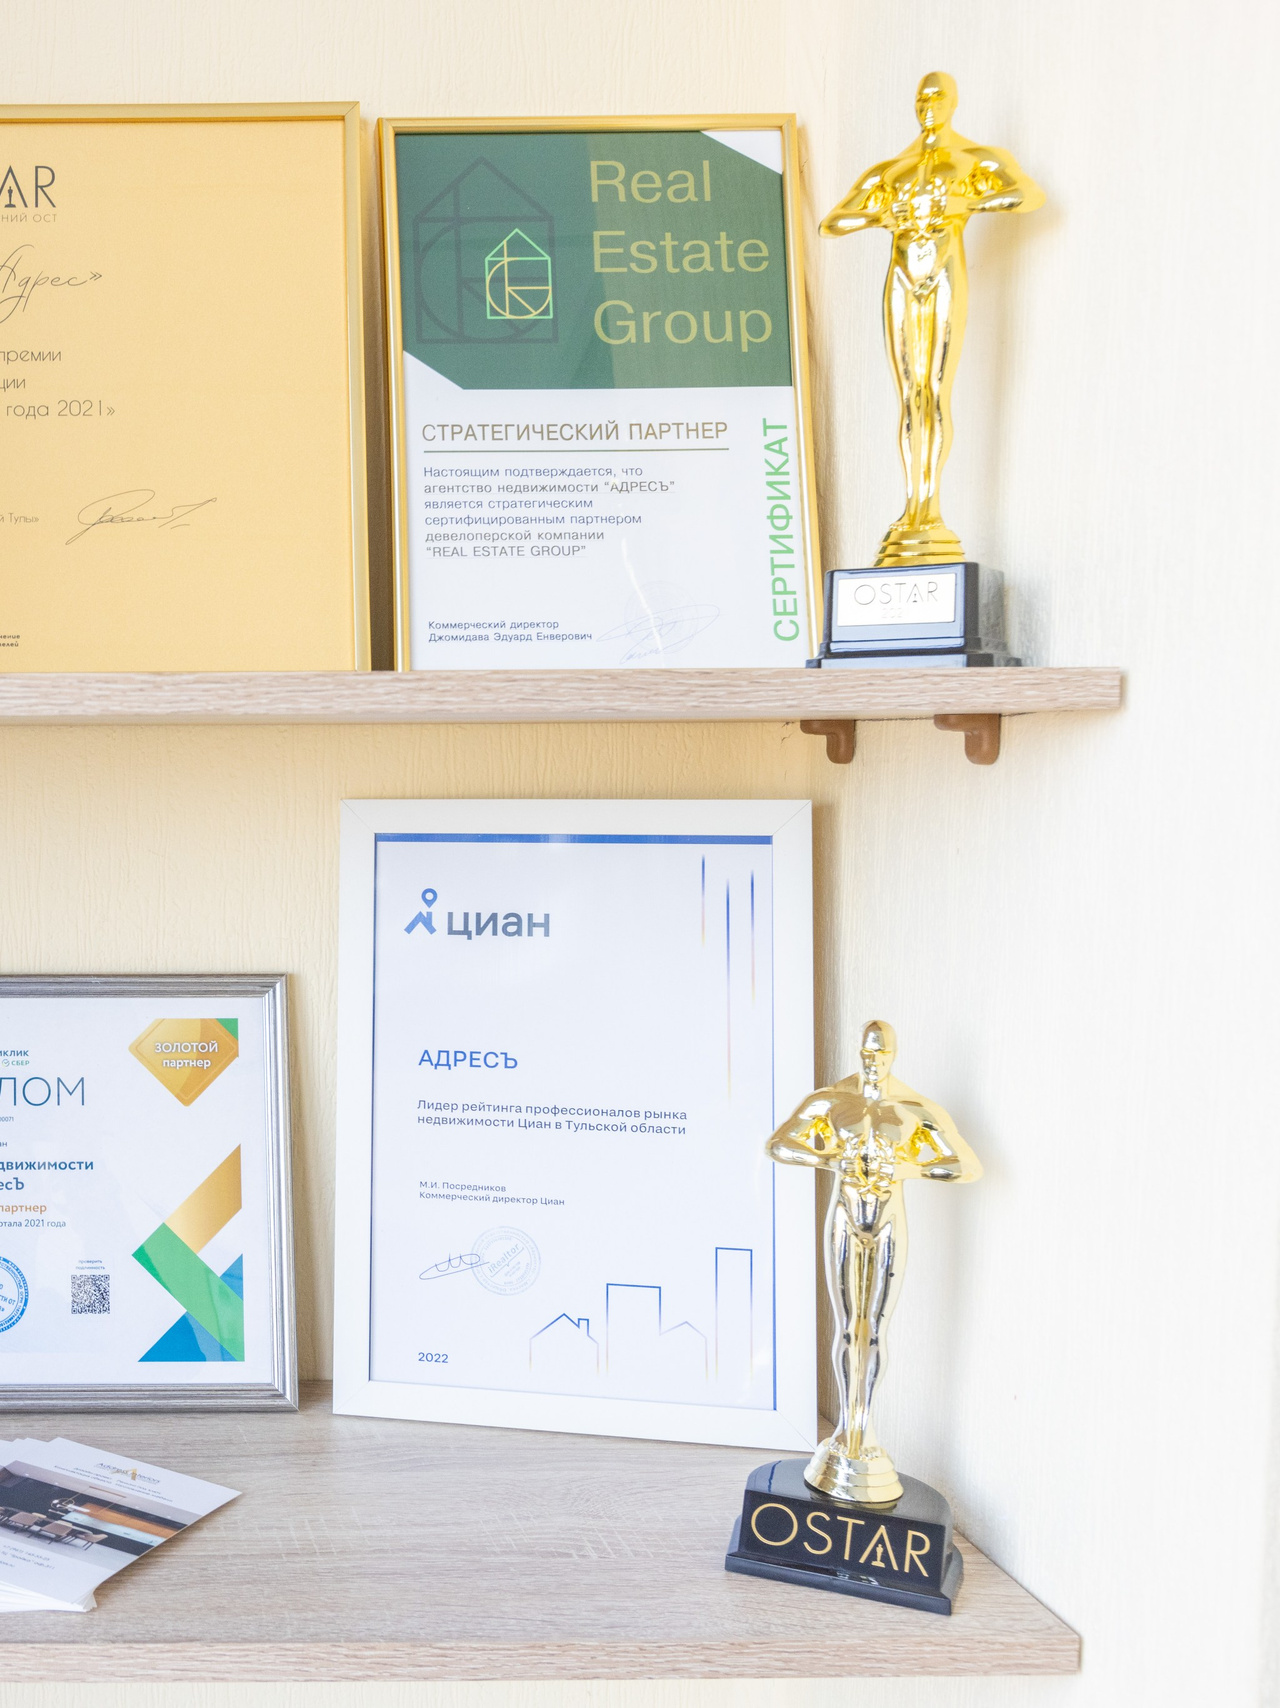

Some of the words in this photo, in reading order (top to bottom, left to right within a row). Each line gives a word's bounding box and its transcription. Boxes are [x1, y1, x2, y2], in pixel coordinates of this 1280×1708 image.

[590, 160, 712, 203] Real
[33, 214, 57, 223] ОСТ
[593, 231, 770, 274] Estate
[594, 300, 772, 353] Group
[7, 405, 49, 419] года
[57, 400, 116, 417] 2021»
[421, 421, 620, 442] СТРАТЕГИЧЕСКИЙ
[628, 421, 728, 441] ПАРТНЕР
[423, 467, 500, 478] Настоящим
[504, 466, 617, 478] подтверждается,
[621, 467, 643, 477] что
[424, 484, 492, 493] агентство
[497, 482, 598, 494] недвижимости
[424, 500, 483, 509] является
[488, 499, 593, 510] стратегическим
[425, 513, 565, 527] сертифицированным
[570, 514, 642, 526] партнером
[762, 416, 801, 642] СЕРТИФИКАТ
[425, 530, 531, 543] девелоперской
[537, 531, 604, 541] компании
[473, 546, 525, 557] ESTATE
[854, 581, 938, 605] OSTAR
[428, 621, 506, 629] Коммерческий
[510, 621, 559, 629] директор
[428, 633, 489, 642] Джомидава
[493, 633, 532, 642] Эдуард
[536, 632, 592, 642] Енверович
[447, 911, 550, 940] циан
[155, 1040, 218, 1053] ЗОЛОТОЙ
[162, 1058, 211, 1069] партнер
[418, 1050, 518, 1069] АДРЕСЪ
[417, 1100, 459, 1112] Лидер
[462, 1102, 522, 1115] рейтинга
[525, 1103, 641, 1119] профессионалов
[644, 1110, 687, 1120] рынка
[417, 1116, 514, 1127] недвижимости
[518, 1118, 552, 1131] Циан
[565, 1120, 627, 1132] Тульской
[630, 1123, 686, 1134] области
[442, 1182, 506, 1192] Посредников
[419, 1191, 491, 1203] Коммерческий
[493, 1195, 538, 1204] директор
[540, 1197, 565, 1205] Циан
[24, 1219, 45, 1227] 2021
[47, 1220, 66, 1229] года
[487, 1243, 520, 1274] iRealtor
[418, 1352, 448, 1363] 2022
[751, 1503, 931, 1578] OSTAR
